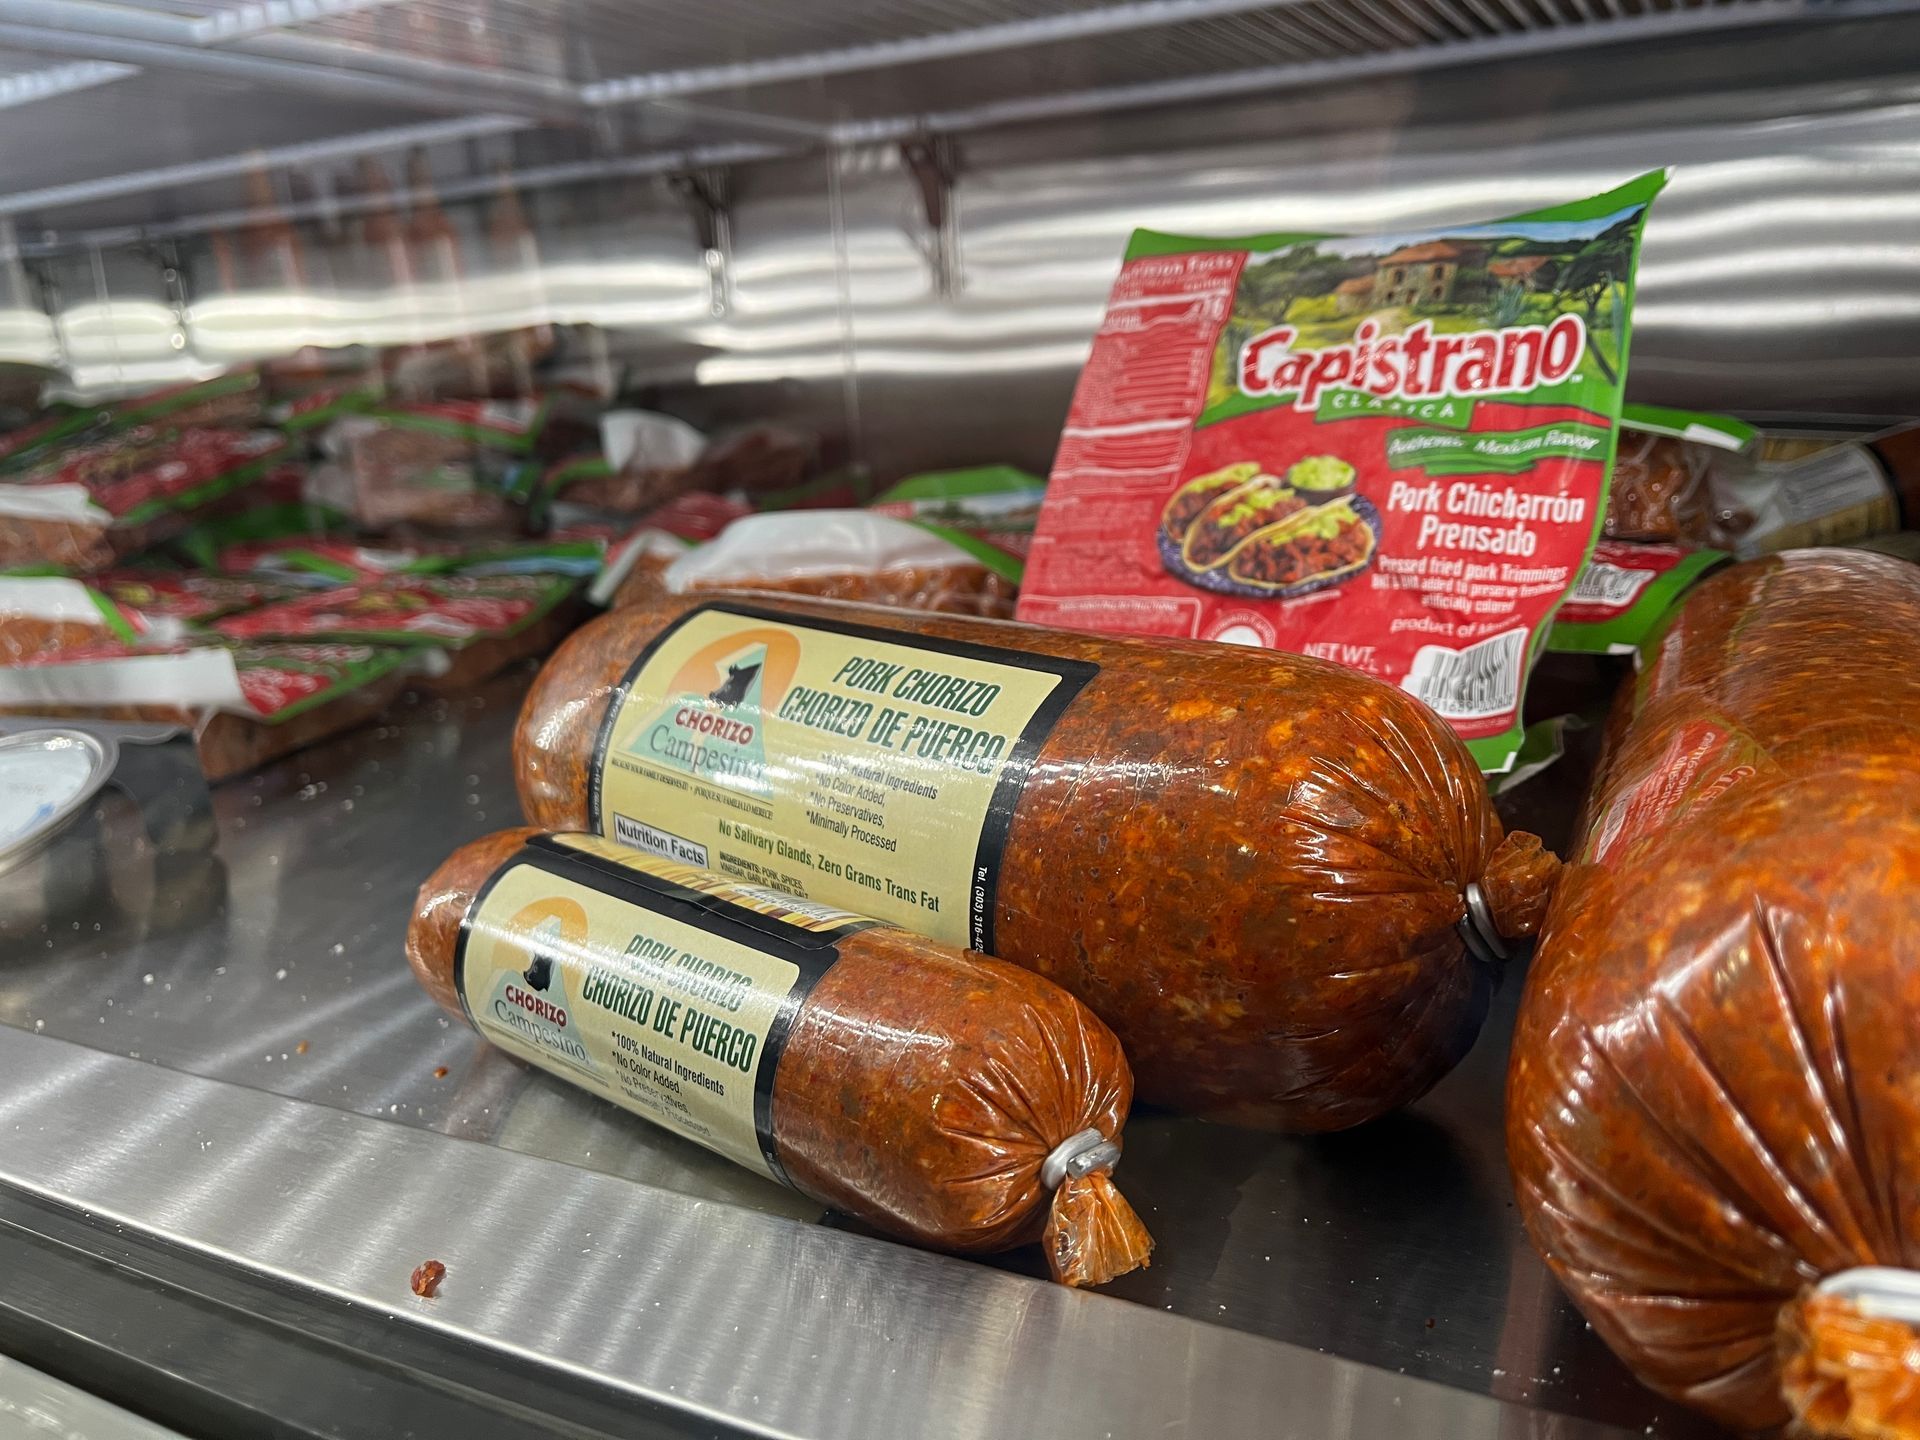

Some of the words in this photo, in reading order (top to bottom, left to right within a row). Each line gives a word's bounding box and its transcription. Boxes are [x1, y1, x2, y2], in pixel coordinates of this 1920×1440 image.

[1241, 315, 1584, 411] Capistrano
[1387, 481, 1444, 513] Pork
[1447, 482, 1586, 523] Chicharrón
[1417, 515, 1538, 557] Prensado
[1378, 554, 1428, 575] Pressed
[1429, 556, 1463, 576] fried
[1465, 563, 1498, 582] pork
[1502, 563, 1569, 582] Trimmings
[1421, 577, 1454, 593] added
[1456, 579, 1468, 594] to
[1470, 584, 1518, 599] preserve
[1390, 616, 1454, 634] product
[1456, 622, 1475, 638] of
[1302, 643, 1337, 662] NET
[832, 656, 905, 694] PORK
[892, 668, 1002, 717] CHORIZO
[675, 706, 754, 746] CHORIZO
[778, 686, 874, 738] CHORIZO
[867, 708, 910, 748] DE
[901, 716, 1007, 776] PUERCO
[832, 777, 857, 798] Color
[856, 785, 886, 808] Added,
[851, 765, 885, 785] Natural
[885, 774, 938, 800] Ingredients
[828, 796, 885, 830] Preservatives,
[617, 817, 668, 852] Nutrition
[671, 839, 705, 865] Facts
[851, 825, 897, 852] Processed
[719, 819, 732, 837] No
[734, 826, 773, 856] Salivary
[776, 841, 815, 870] Glands,
[818, 854, 842, 876] Zero
[845, 867, 882, 891] Grams
[885, 878, 917, 904] Trans
[921, 891, 940, 913] Fat
[720, 851, 761, 874] INGREDIENTS:
[977, 867, 988, 882] Tel.
[973, 886, 985, 913] (303)
[505, 984, 567, 1028] CHORIZO
[582, 965, 655, 1026] CHORIZO
[653, 996, 682, 1038] DE
[680, 1008, 758, 1073] PUERCO
[495, 1000, 586, 1061] Campesino
[629, 1059, 651, 1079] Color
[653, 1071, 683, 1096] Added,
[641, 1044, 672, 1071] Natural
[674, 1060, 725, 1096] Ingredients
